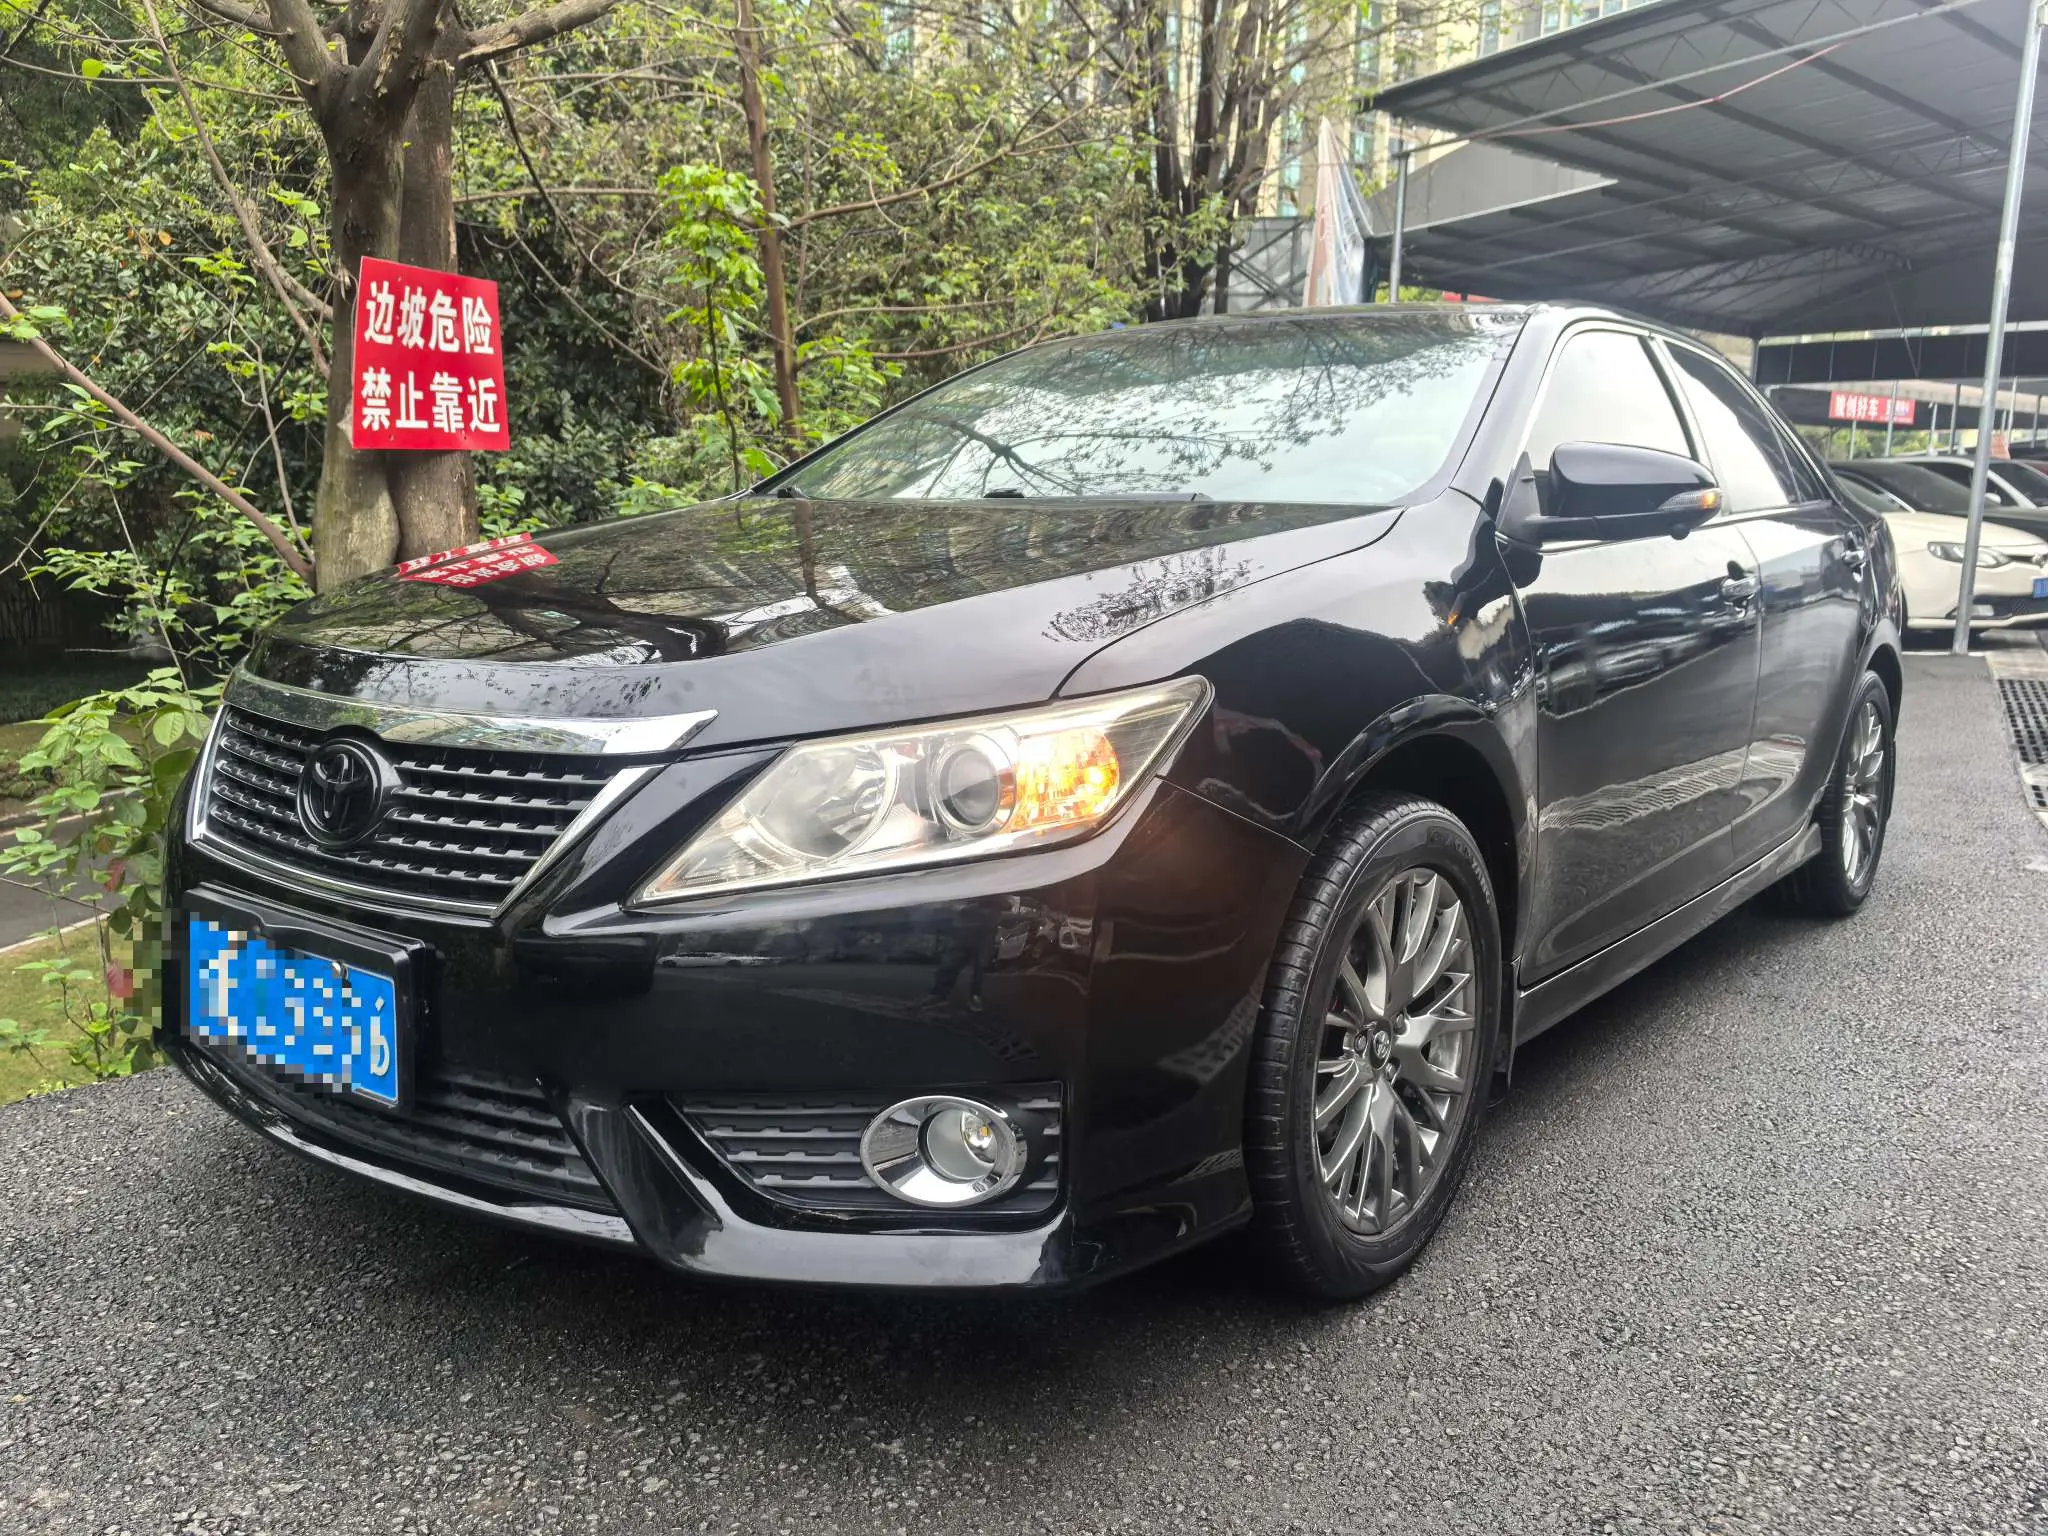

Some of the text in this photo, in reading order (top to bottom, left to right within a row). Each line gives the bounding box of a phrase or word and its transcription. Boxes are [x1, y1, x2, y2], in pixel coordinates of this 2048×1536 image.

[364, 281, 494, 355] 边坡危险
[361, 366, 500, 433] 禁止靠近
